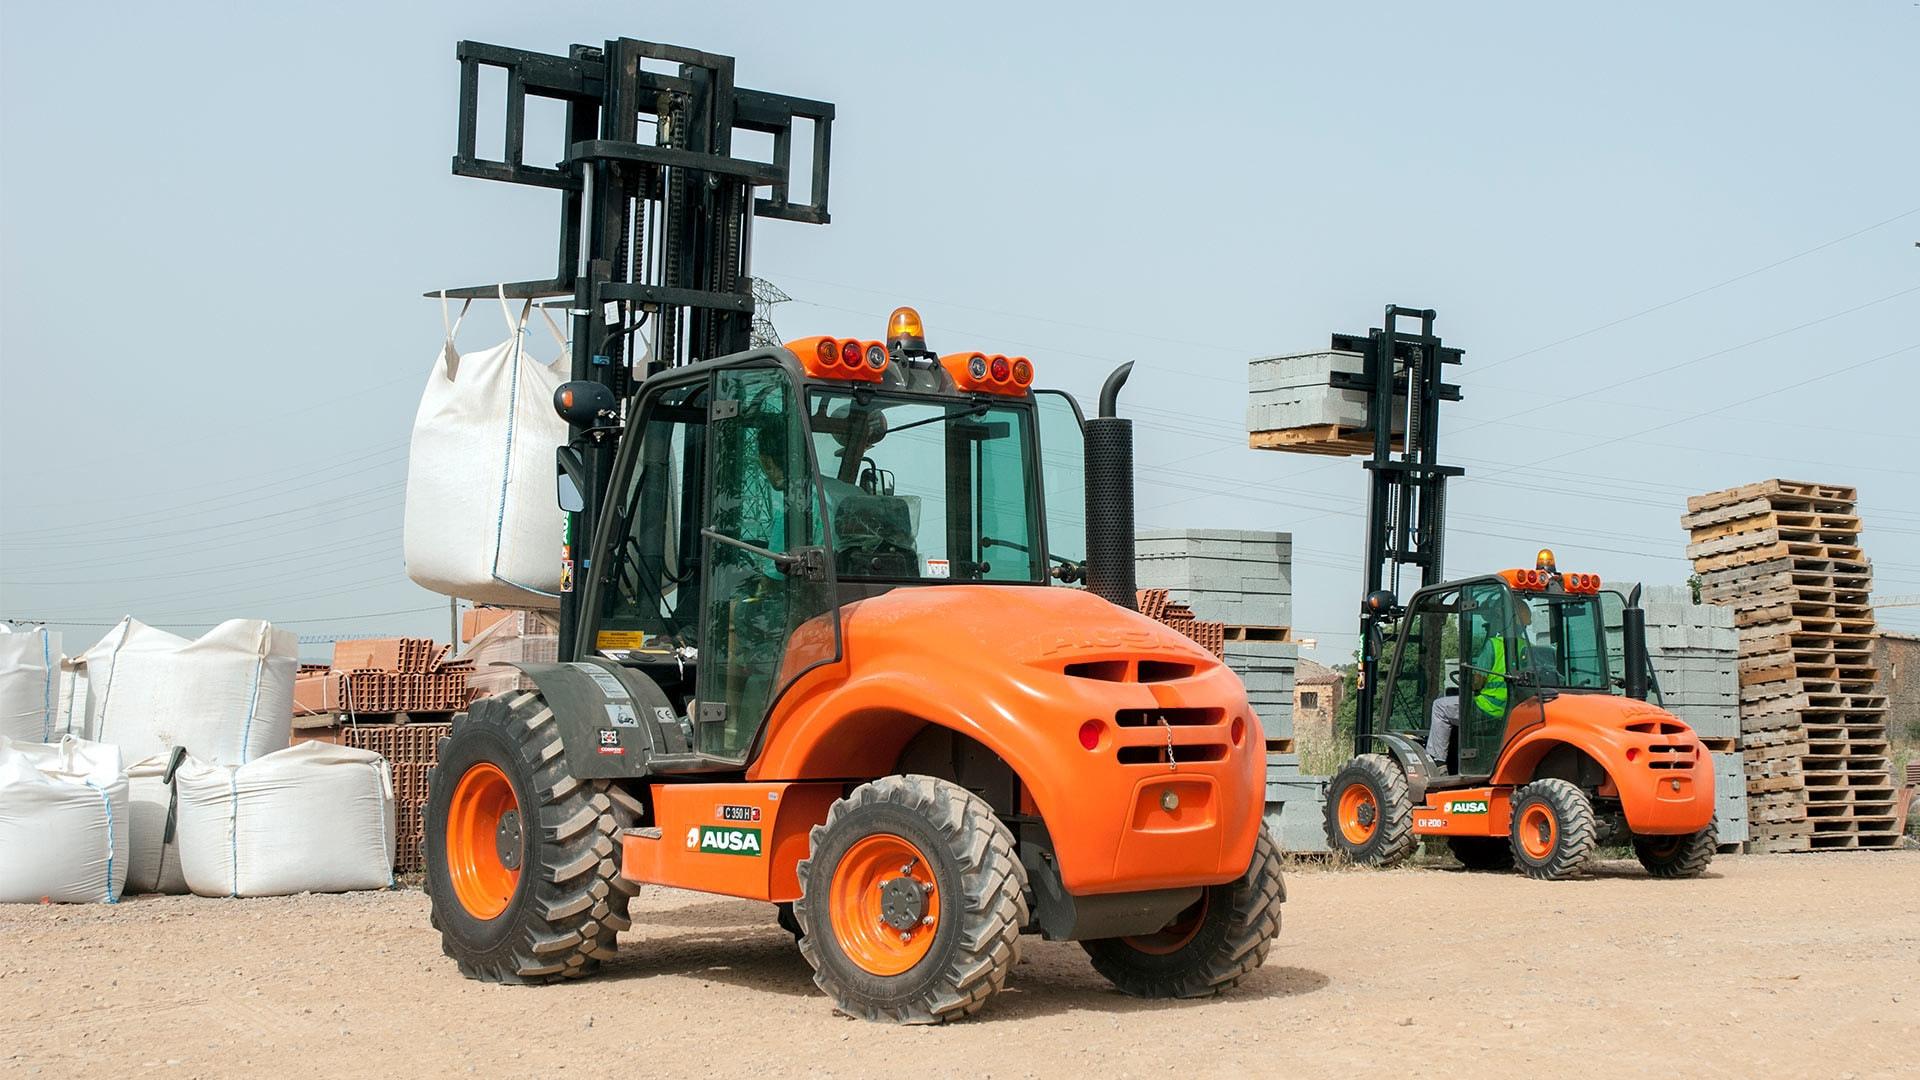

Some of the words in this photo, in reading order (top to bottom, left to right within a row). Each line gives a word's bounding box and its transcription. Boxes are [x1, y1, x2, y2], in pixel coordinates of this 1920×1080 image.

[657, 710, 672, 720] CE
[1452, 802, 1487, 812] AUSA
[725, 807, 731, 818] C
[732, 807, 743, 819] 350
[744, 808, 750, 820] H
[702, 831, 760, 851] AUSA
